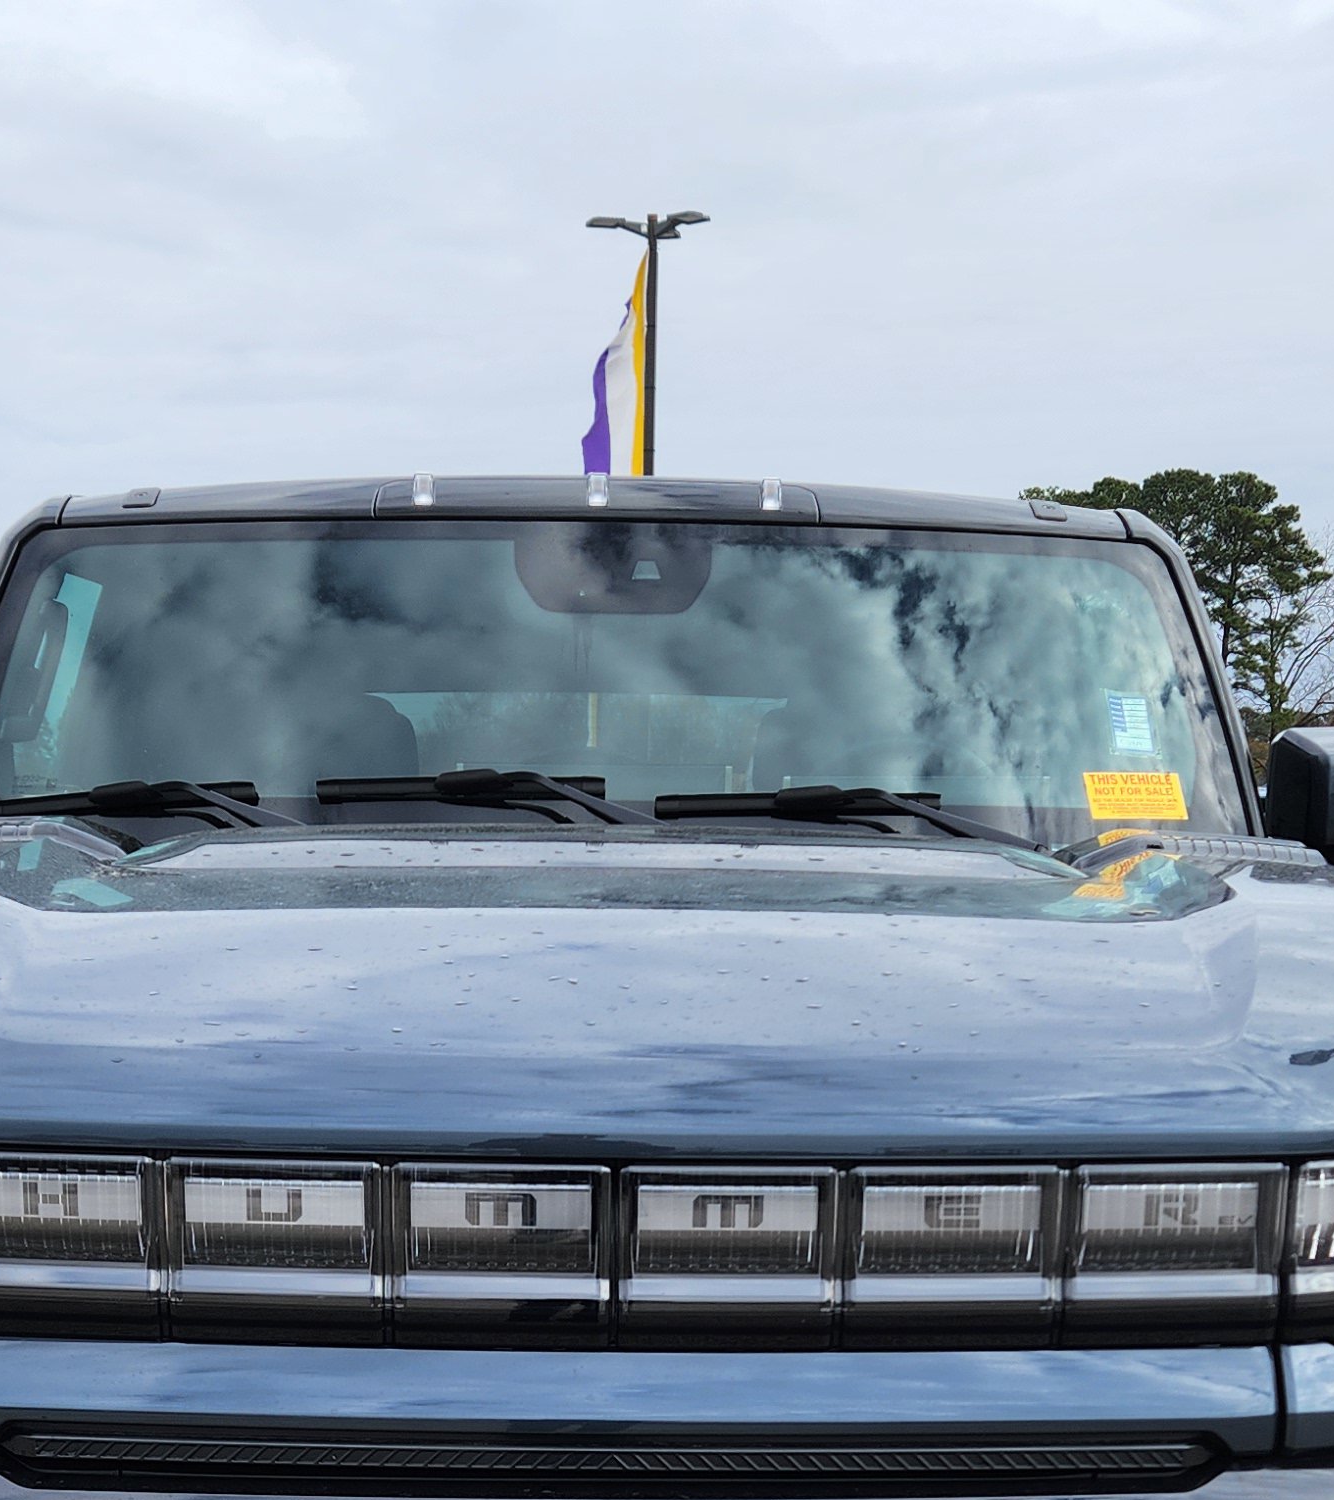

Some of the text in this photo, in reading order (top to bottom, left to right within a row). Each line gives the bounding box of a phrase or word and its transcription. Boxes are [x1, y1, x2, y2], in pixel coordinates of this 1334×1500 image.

[1088, 773, 1173, 785] THIS VEHICLE
[1094, 786, 1174, 796] NOT FOR SALE
[1218, 1215, 1253, 1226] EV
